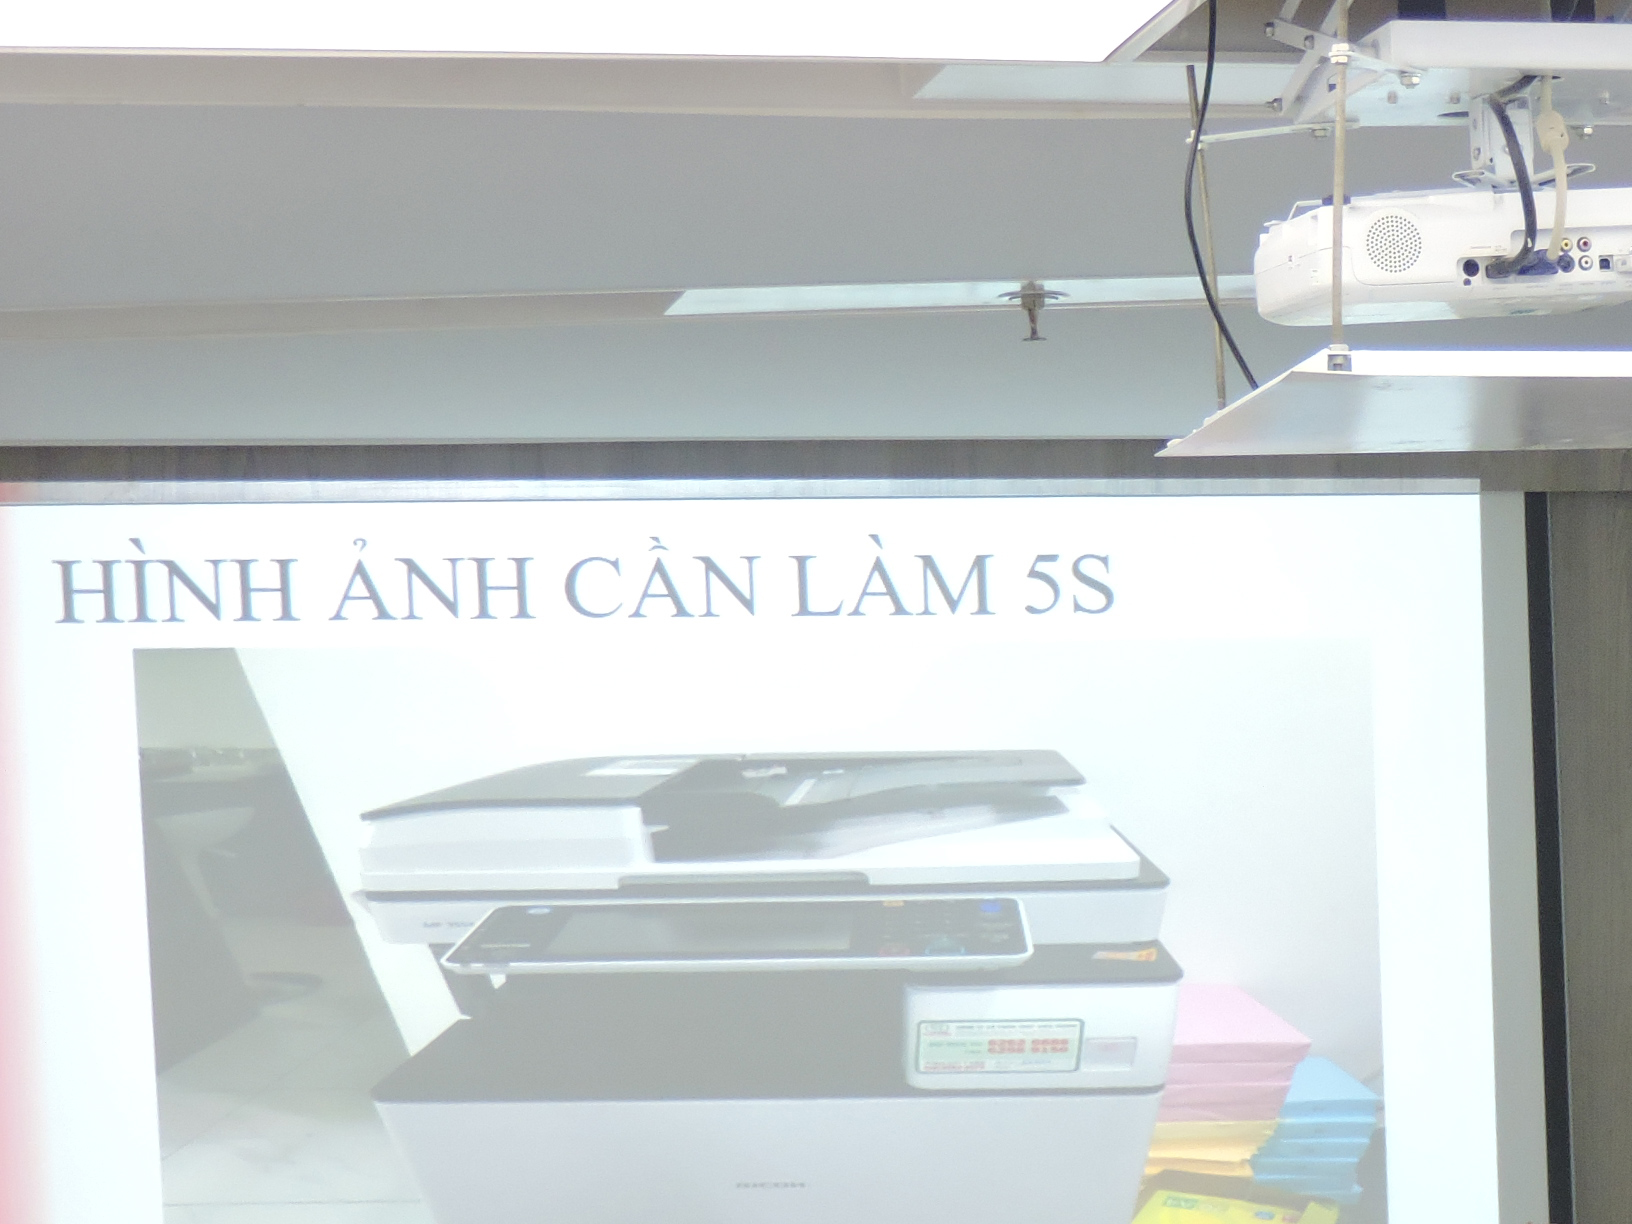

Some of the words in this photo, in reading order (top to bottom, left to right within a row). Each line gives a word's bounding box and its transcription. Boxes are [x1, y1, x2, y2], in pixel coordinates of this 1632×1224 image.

[51, 537, 300, 623] HÌNH
[328, 538, 536, 620] ẢNH
[564, 536, 761, 618] CẦN
[788, 534, 996, 616] LÀM
[1024, 553, 1115, 615] 5S
